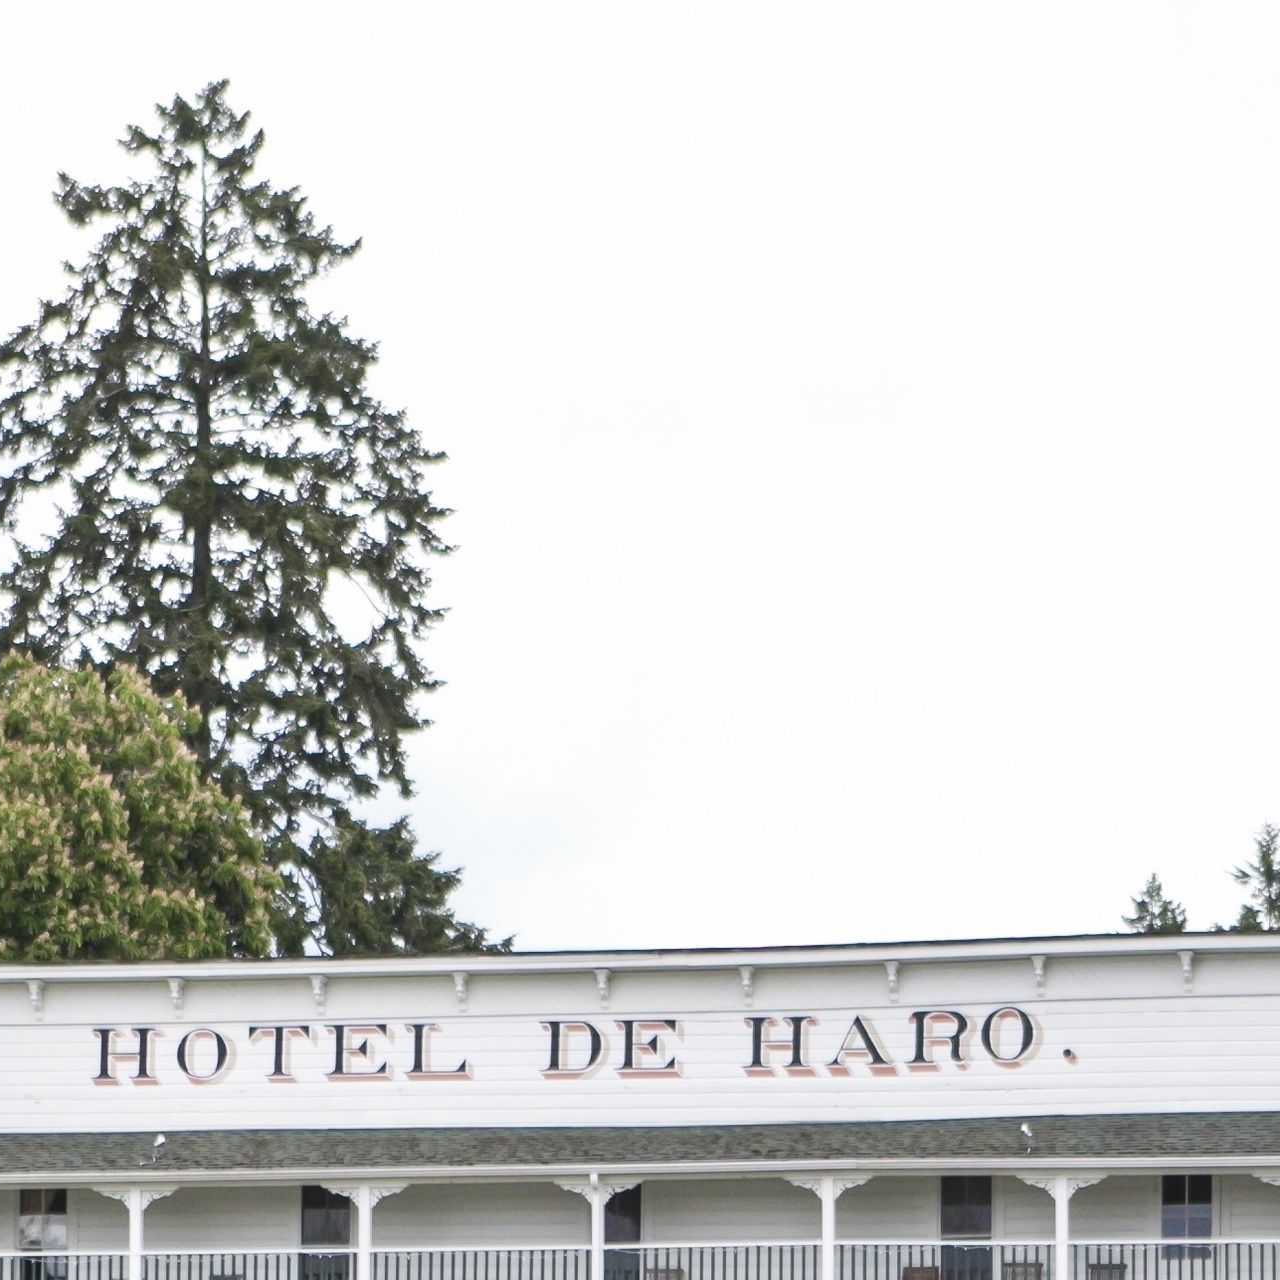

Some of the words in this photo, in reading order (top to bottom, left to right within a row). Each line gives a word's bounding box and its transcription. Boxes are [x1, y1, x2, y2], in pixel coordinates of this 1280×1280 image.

[92, 1024, 473, 1085] HOTEL
[540, 1020, 684, 1079] DE
[742, 1007, 1078, 1078] HARO.
